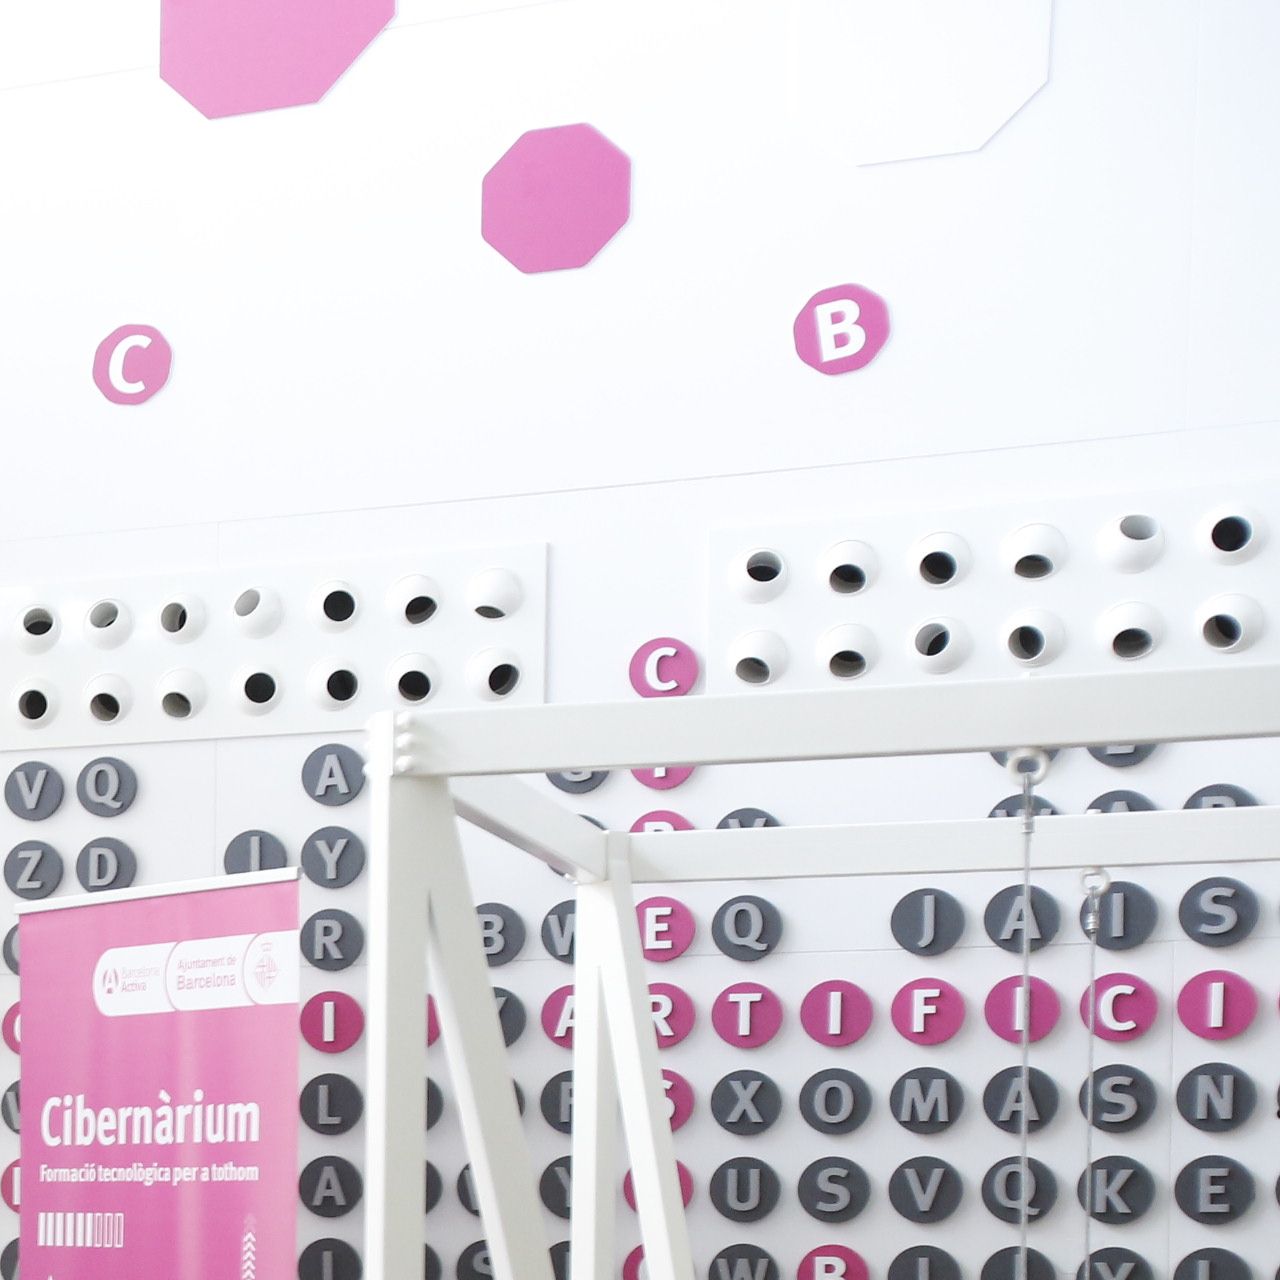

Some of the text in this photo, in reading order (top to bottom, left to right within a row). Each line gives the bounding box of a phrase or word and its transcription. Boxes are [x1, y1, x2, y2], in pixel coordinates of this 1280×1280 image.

[814, 297, 868, 364] B
[107, 334, 153, 396] C
[316, 754, 349, 797] A
[314, 920, 341, 960] R
[176, 973, 237, 991] Barcelona
[40, 1089, 260, 1147] Cibernàrium
[39, 1162, 260, 1187] Formació tecnològica per a tothom
